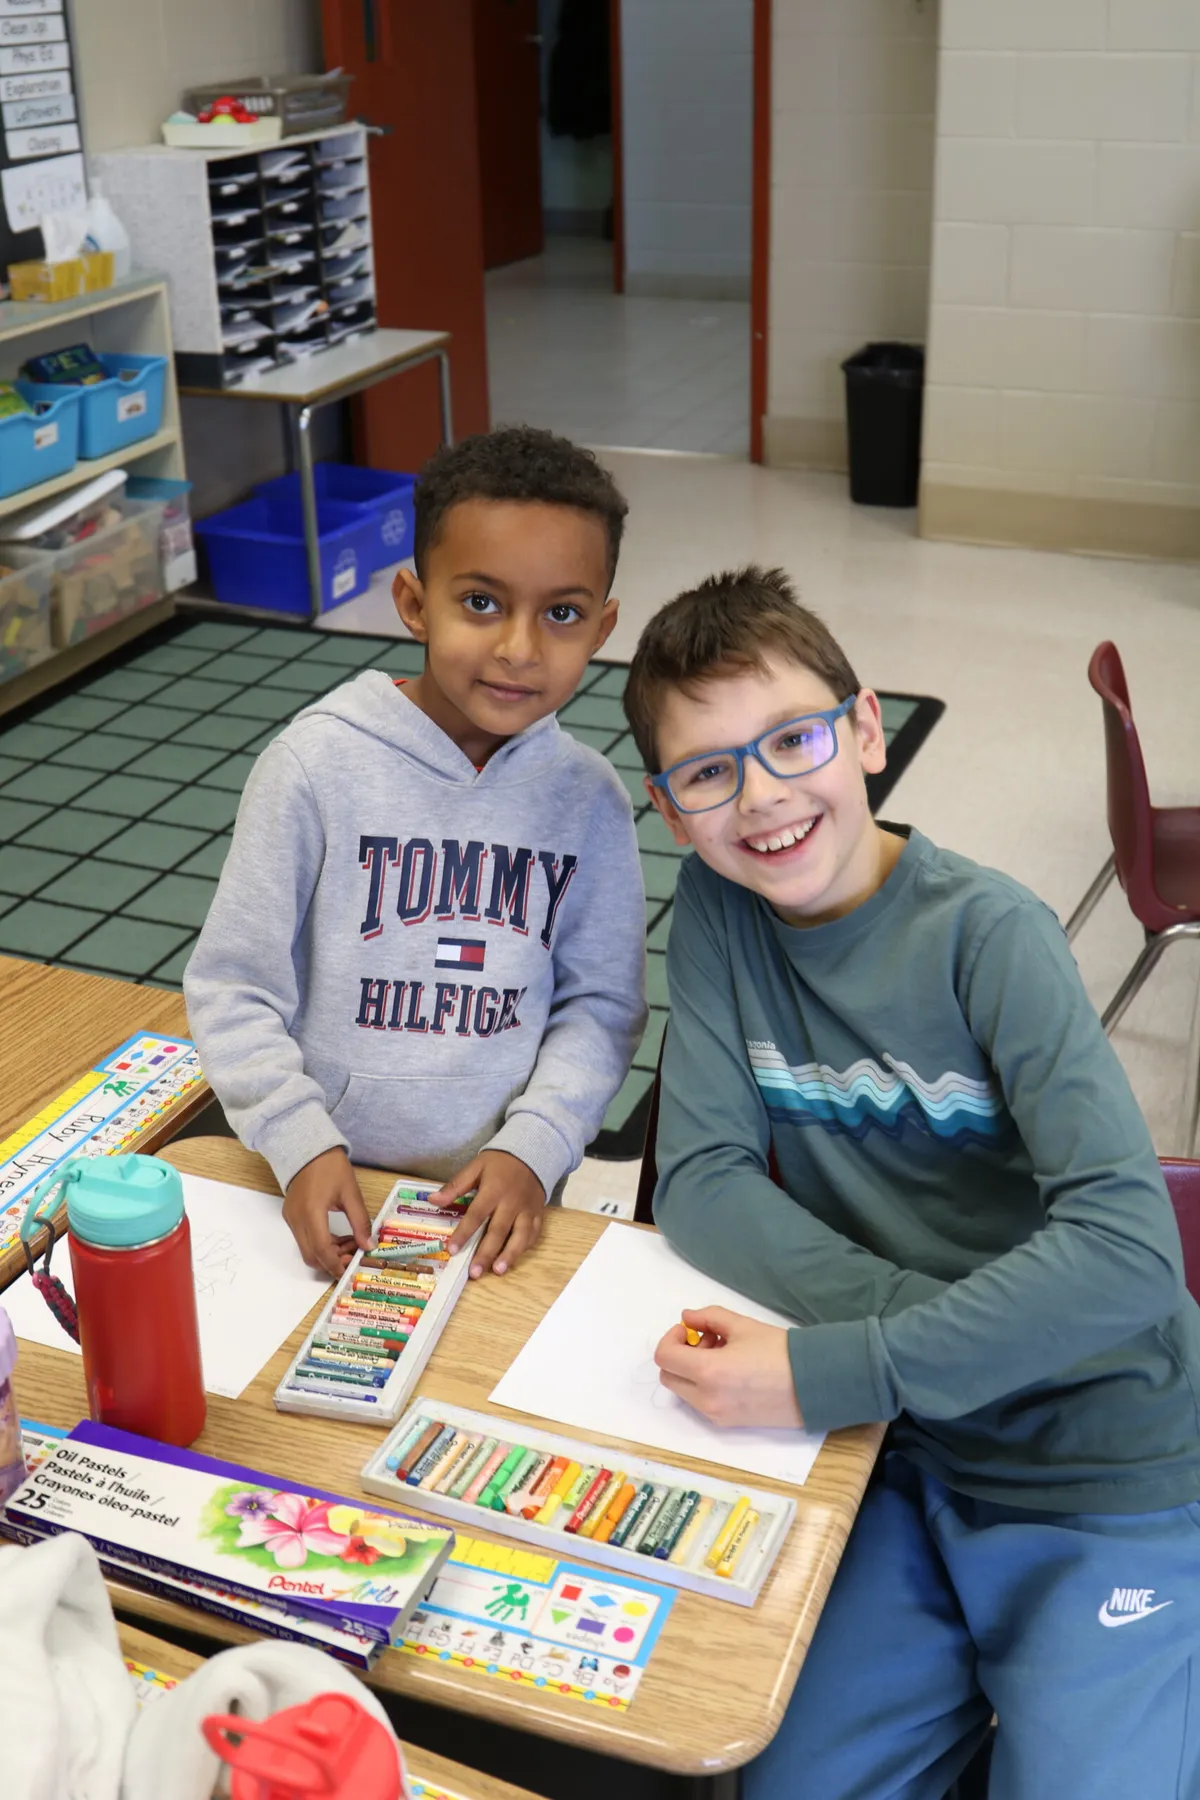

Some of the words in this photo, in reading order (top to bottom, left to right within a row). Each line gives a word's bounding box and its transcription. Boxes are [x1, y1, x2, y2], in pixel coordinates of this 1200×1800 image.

[359, 835, 577, 951] TOMMY
[48, 1113, 105, 1142] Ruby
[365, 1285, 387, 1297] Pentel
[371, 1274, 393, 1285] Pentel
[56, 1449, 78, 1463] Oil
[78, 1457, 128, 1479] Pastels
[44, 1461, 92, 1484] Pastels
[96, 1477, 106, 1488] à
[108, 1480, 150, 1503] l'huile
[16, 1488, 51, 1510] 25
[34, 1473, 96, 1501] Crayones
[98, 1493, 180, 1527] óleo-pastel
[268, 1575, 325, 1596] Pentel
[322, 1580, 399, 1602] Arts
[1109, 1587, 1155, 1612] NIKE
[340, 1618, 365, 1636] 25
